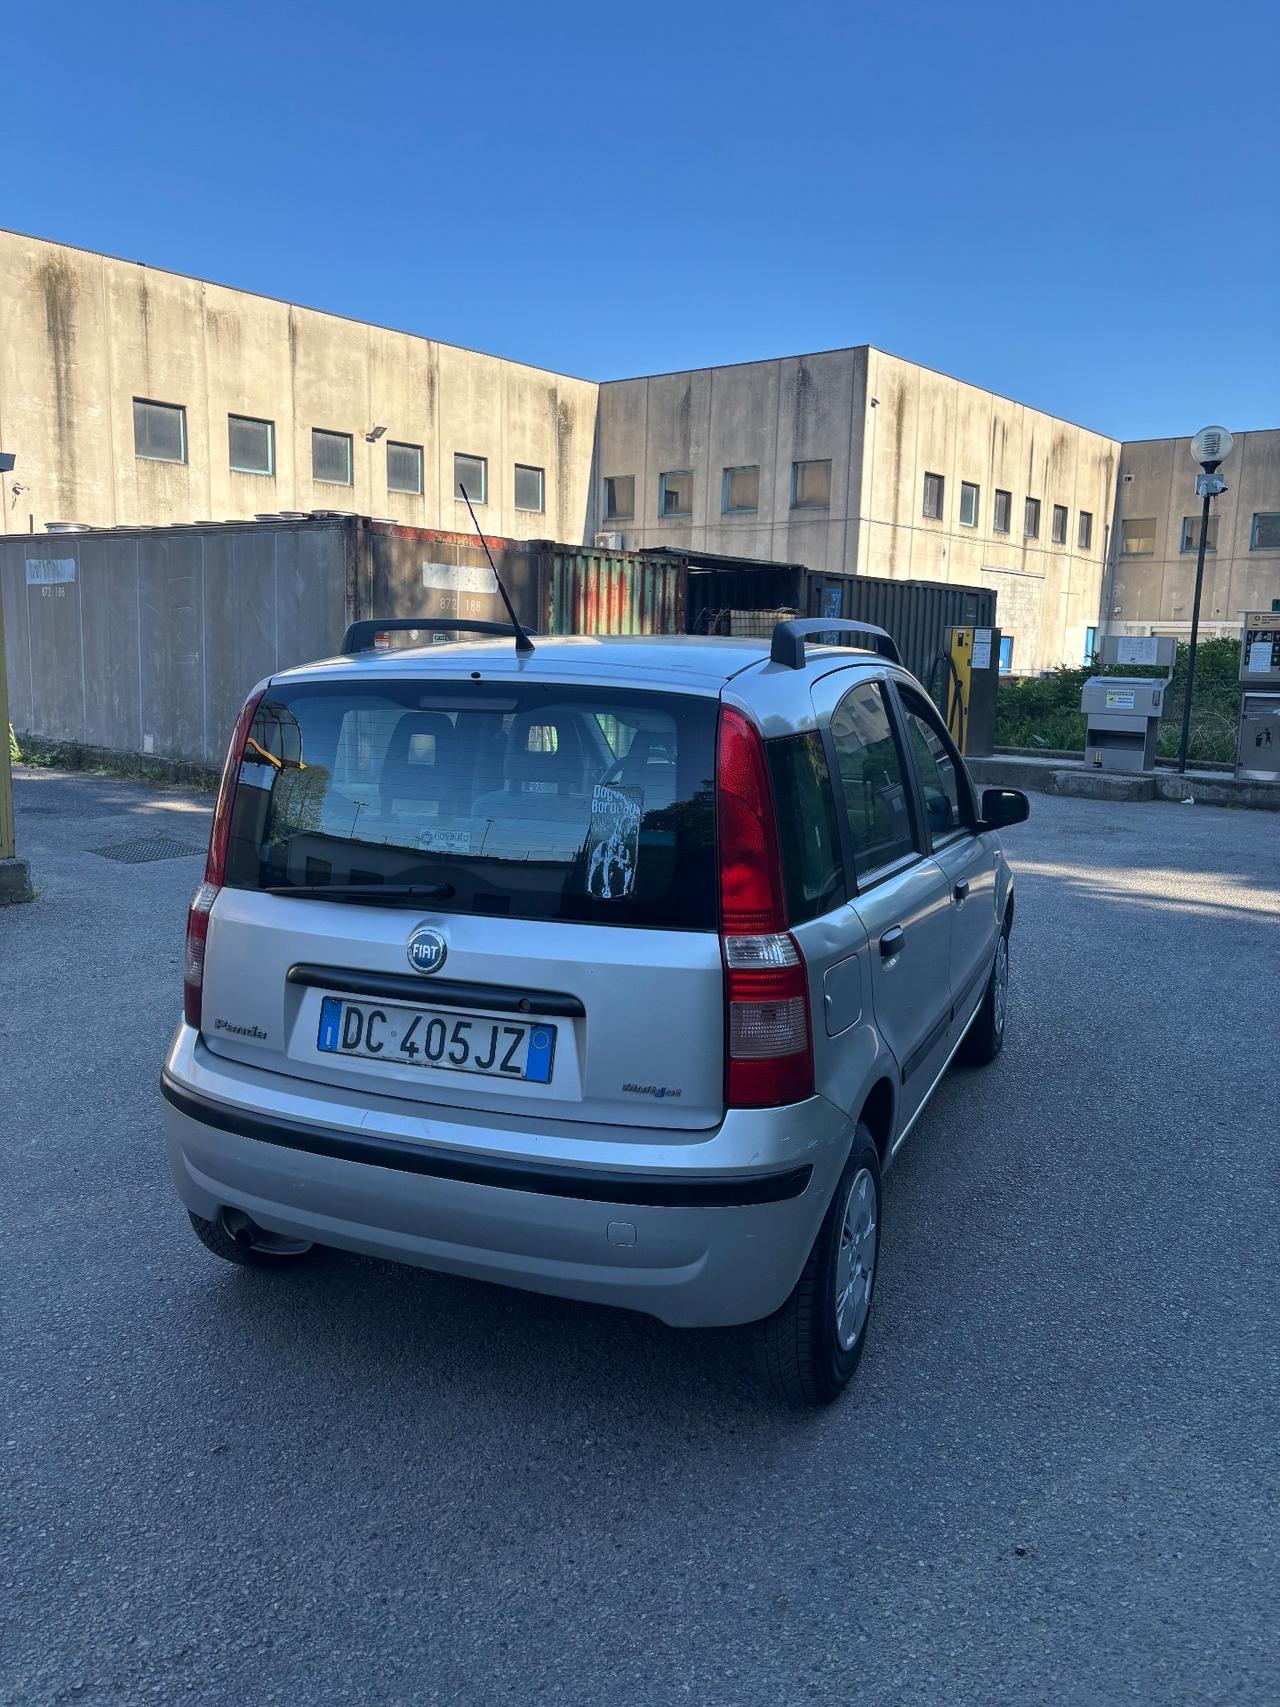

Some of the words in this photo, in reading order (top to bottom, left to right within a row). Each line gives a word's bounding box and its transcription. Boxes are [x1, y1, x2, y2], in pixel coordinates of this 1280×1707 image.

[439, 597, 458, 611] 872
[464, 599, 482, 613] 188
[412, 943, 439, 960] FIAT
[214, 1016, 268, 1040] Panda
[342, 1006, 388, 1053] DC
[399, 1015, 526, 1074] 405JZ
